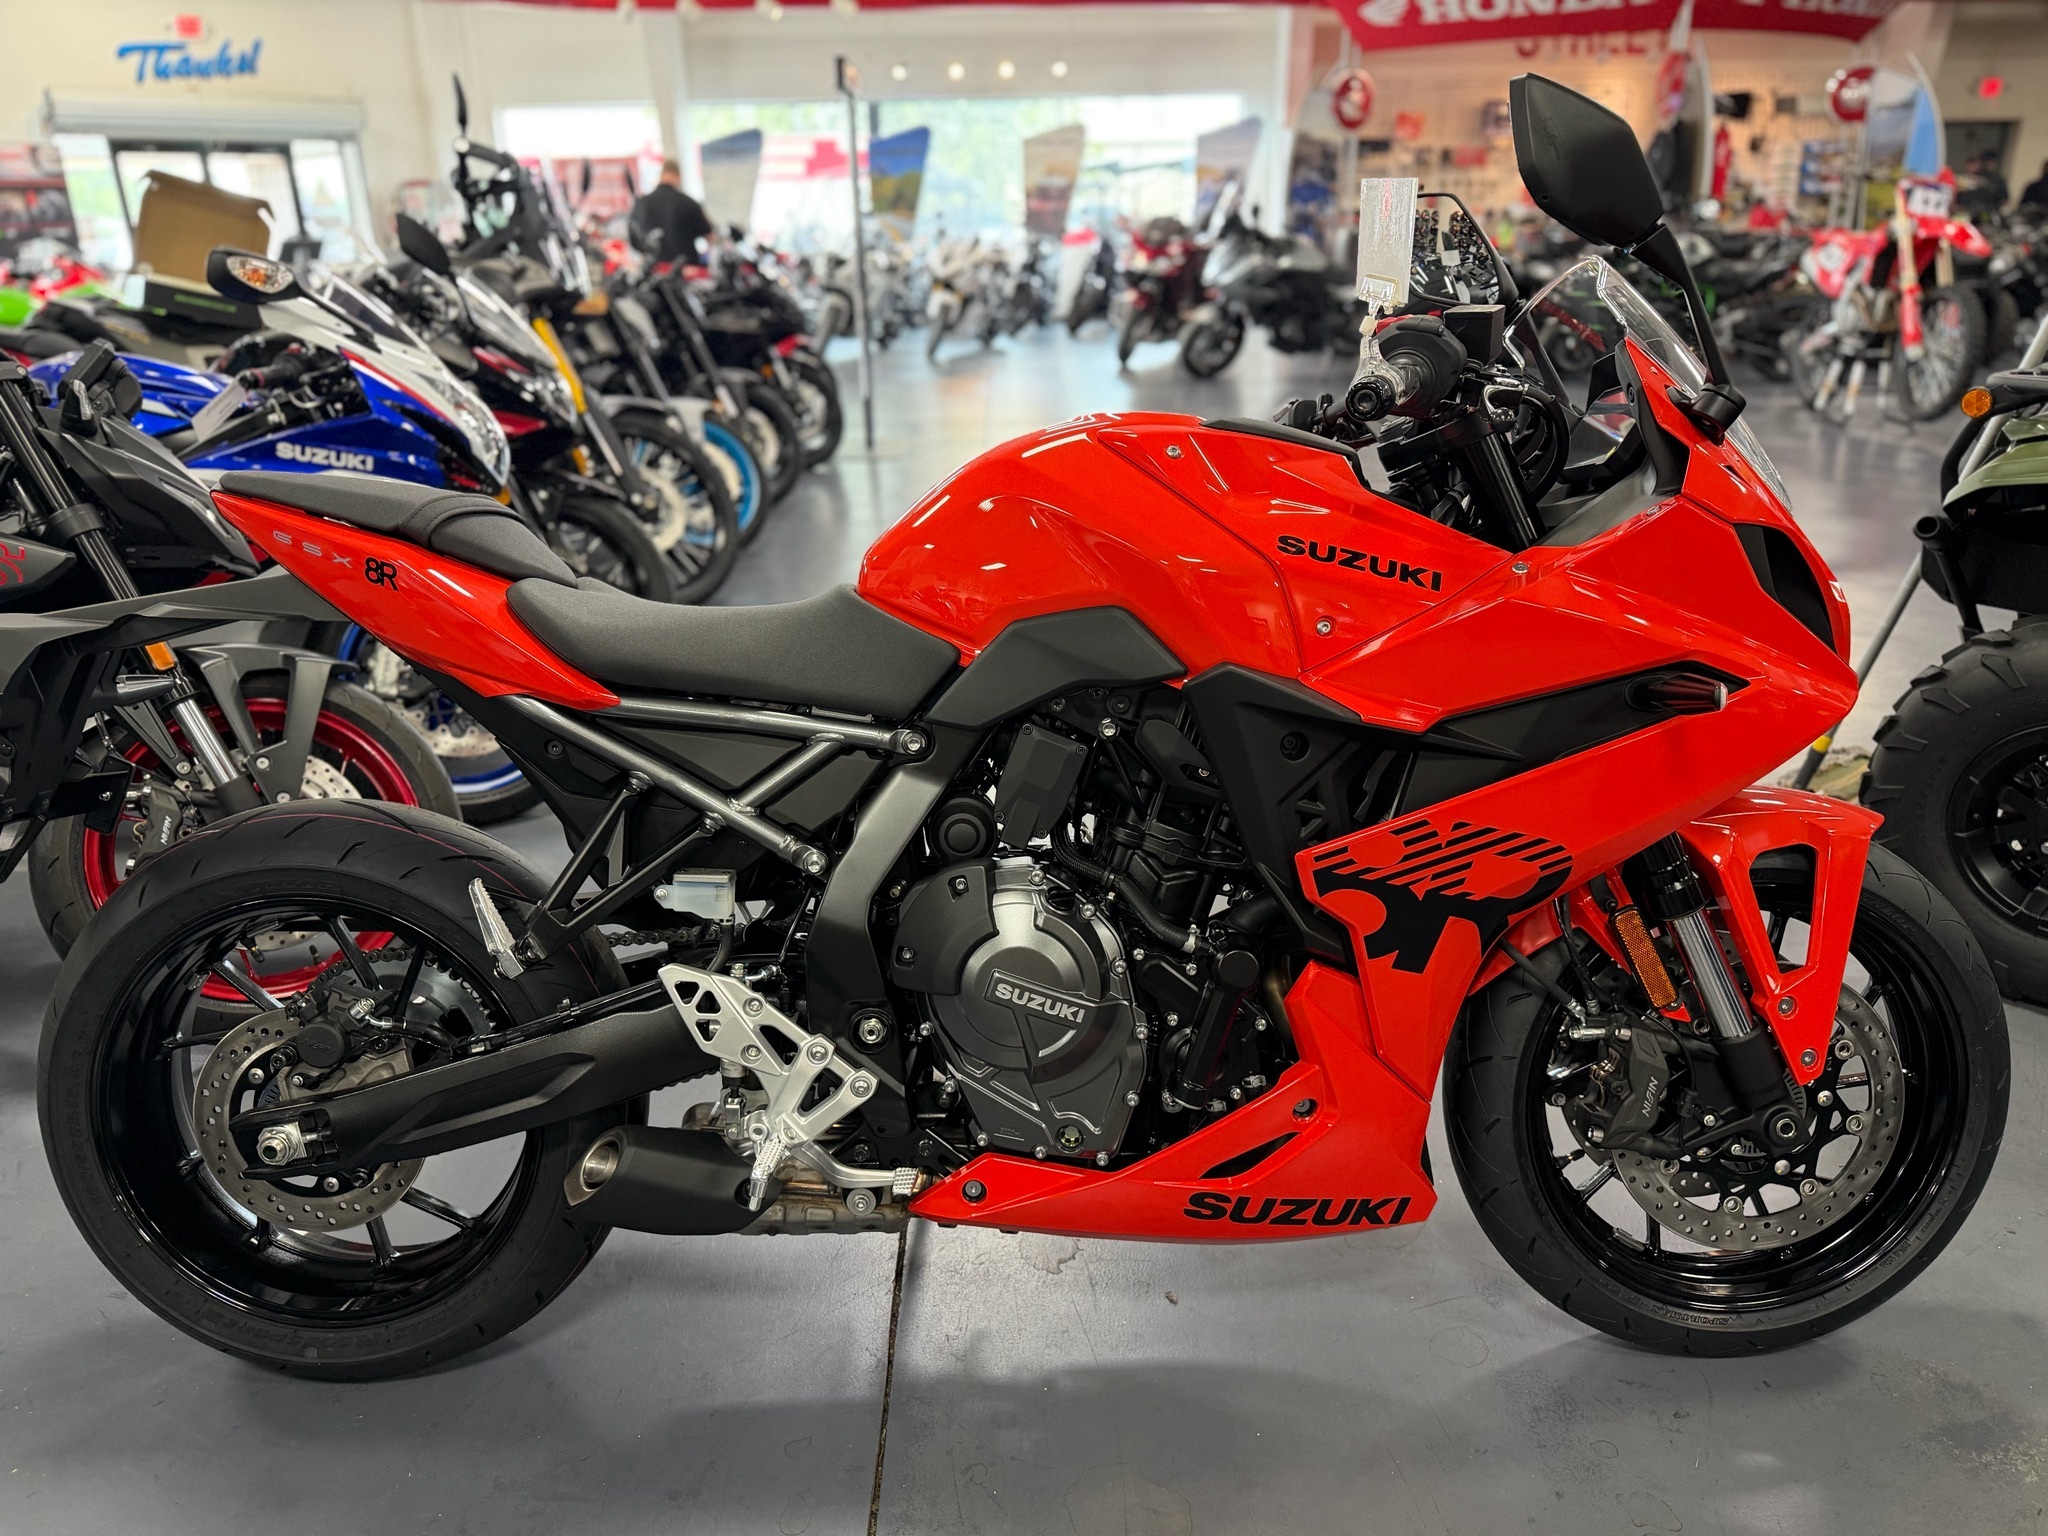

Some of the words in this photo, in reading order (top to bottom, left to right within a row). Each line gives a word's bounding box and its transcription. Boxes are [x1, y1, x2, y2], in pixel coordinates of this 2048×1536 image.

[1419, 0, 1660, 25] HON
[275, 441, 375, 472] SUZUKI
[272, 530, 353, 569] GSX
[364, 556, 399, 592] 8R
[1276, 534, 1442, 593] SUZUKI
[994, 982, 1086, 1023] SUZUKI
[1641, 1075, 1659, 1118] NISSIN
[1183, 1191, 1412, 1226] SUZUKI
